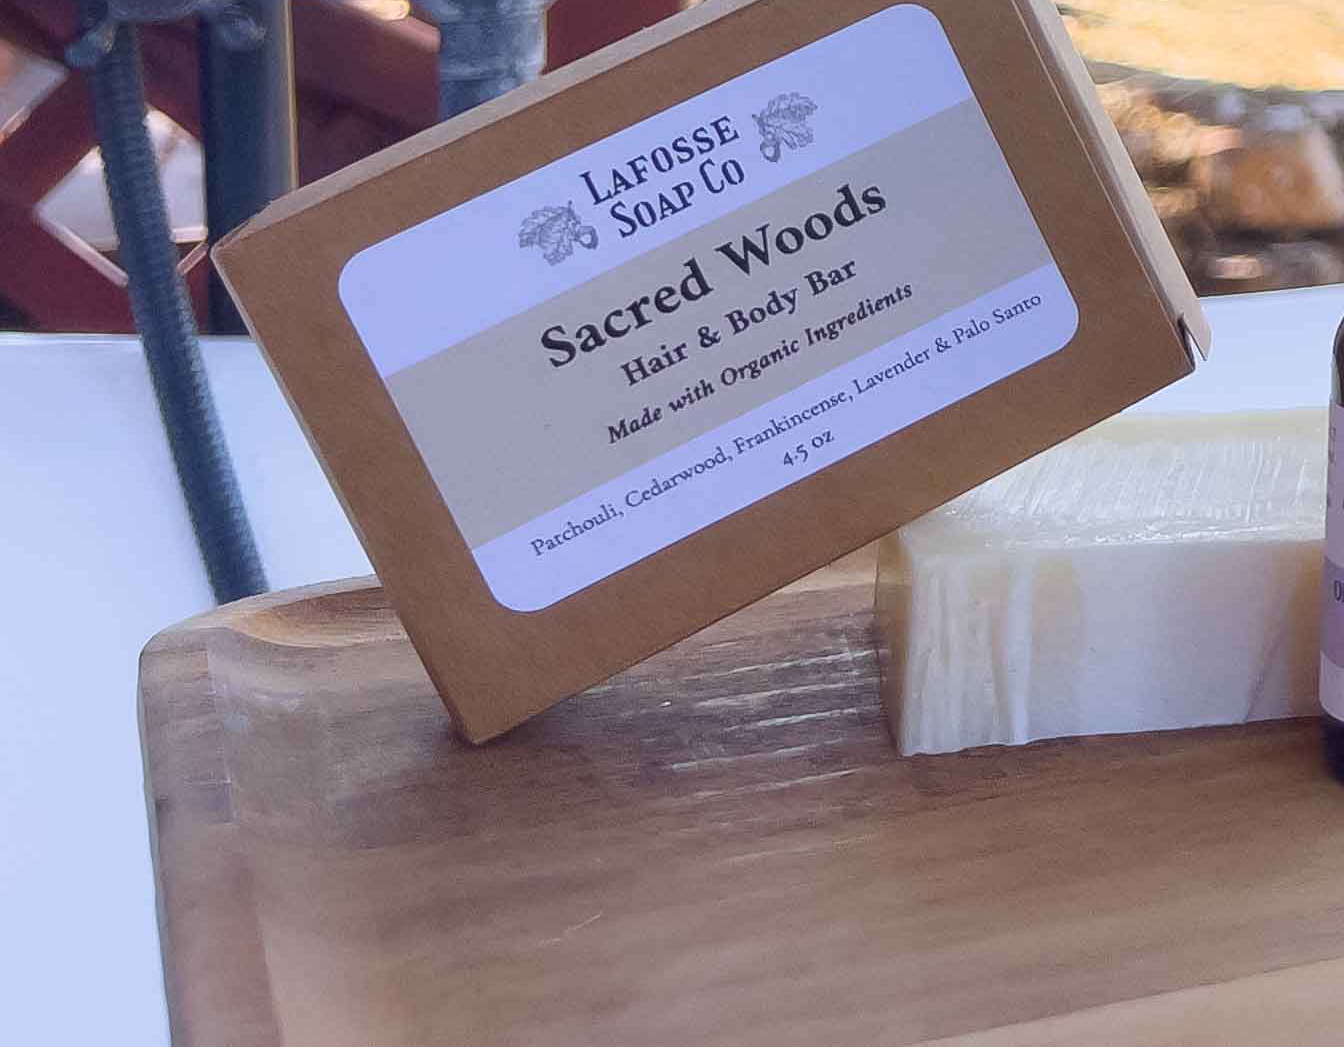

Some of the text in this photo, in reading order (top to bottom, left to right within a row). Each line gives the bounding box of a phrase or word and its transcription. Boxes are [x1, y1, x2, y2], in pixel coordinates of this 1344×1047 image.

[541, 184, 888, 369] Sacred Woods
[620, 258, 858, 387] Hair & Body Bar
[531, 294, 1042, 556] Patchouli, Cedarwood, Frankincense, Lavender & Palo Santo
[607, 281, 914, 443] Made with Organic Ingredients
[782, 429, 836, 468] 4.5 oz
